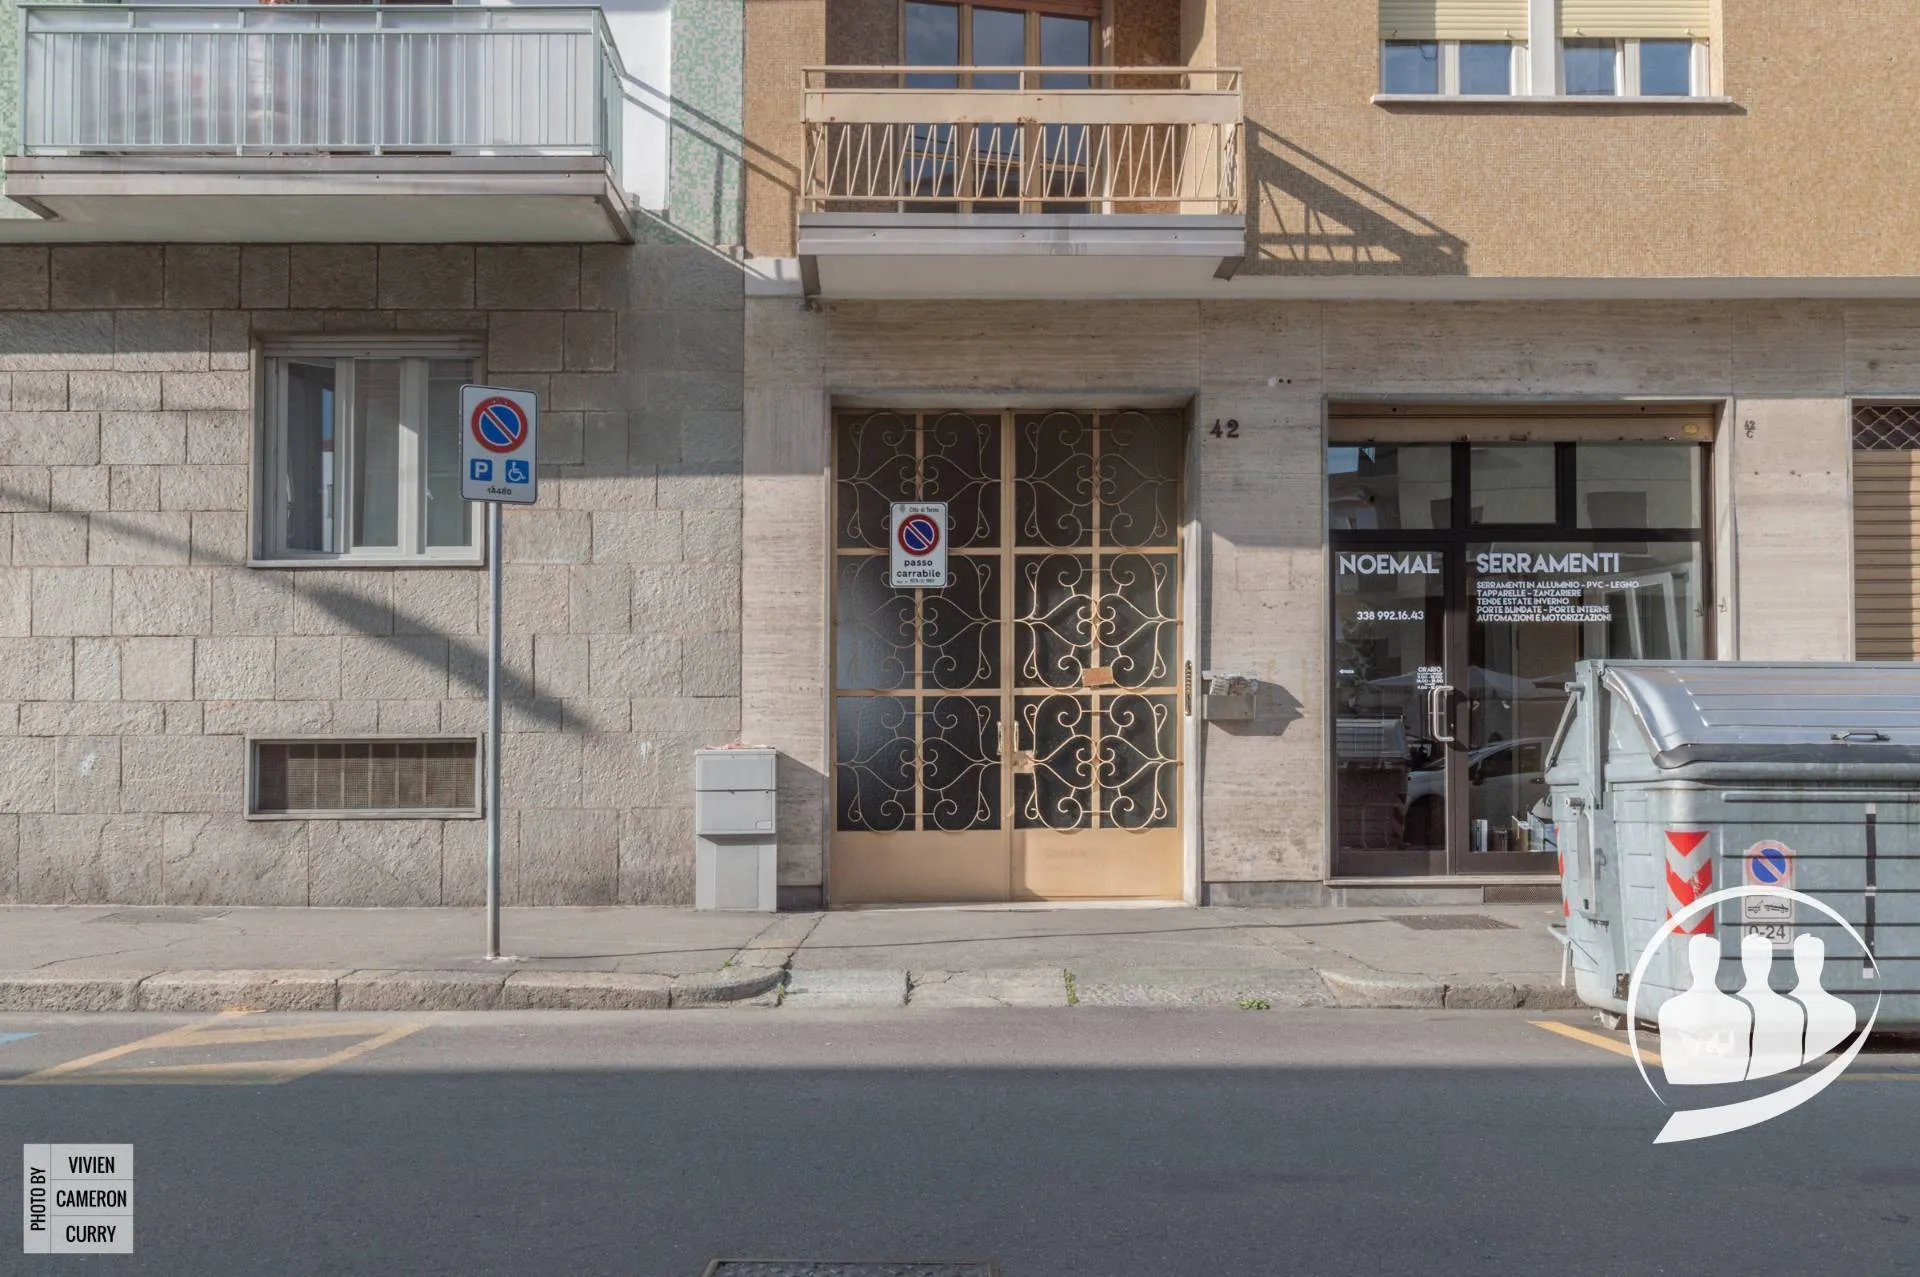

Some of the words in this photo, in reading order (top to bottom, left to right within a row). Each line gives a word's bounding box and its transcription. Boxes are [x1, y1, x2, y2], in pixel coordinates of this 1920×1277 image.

[1209, 418, 1239, 438] 42
[475, 461, 488, 478] P
[1339, 553, 1440, 575] NOEMAL
[1476, 553, 1620, 573] SERRAMENTI
[896, 569, 941, 578] carrabile
[1477, 581, 1525, 589] SERRAMENTI
[1527, 581, 1535, 589] IN
[1537, 581, 1580, 589] ALLUMINIO
[1586, 581, 1605, 589] PVC
[1610, 581, 1640, 589] LEGNO
[1477, 589, 1526, 597] TAPPARELLE
[1533, 589, 1582, 597] ZANZARIERE
[1477, 598, 1502, 606] TENDE
[1503, 598, 1532, 606] ESTATE
[1477, 606, 1503, 614] PORTE
[1357, 611, 1375, 620] 338
[1377, 611, 1425, 620] 992.16.43
[1477, 614, 1535, 622] AUTOMAZIONI
[1542, 614, 1612, 622] MOTORIZZAZIONI
